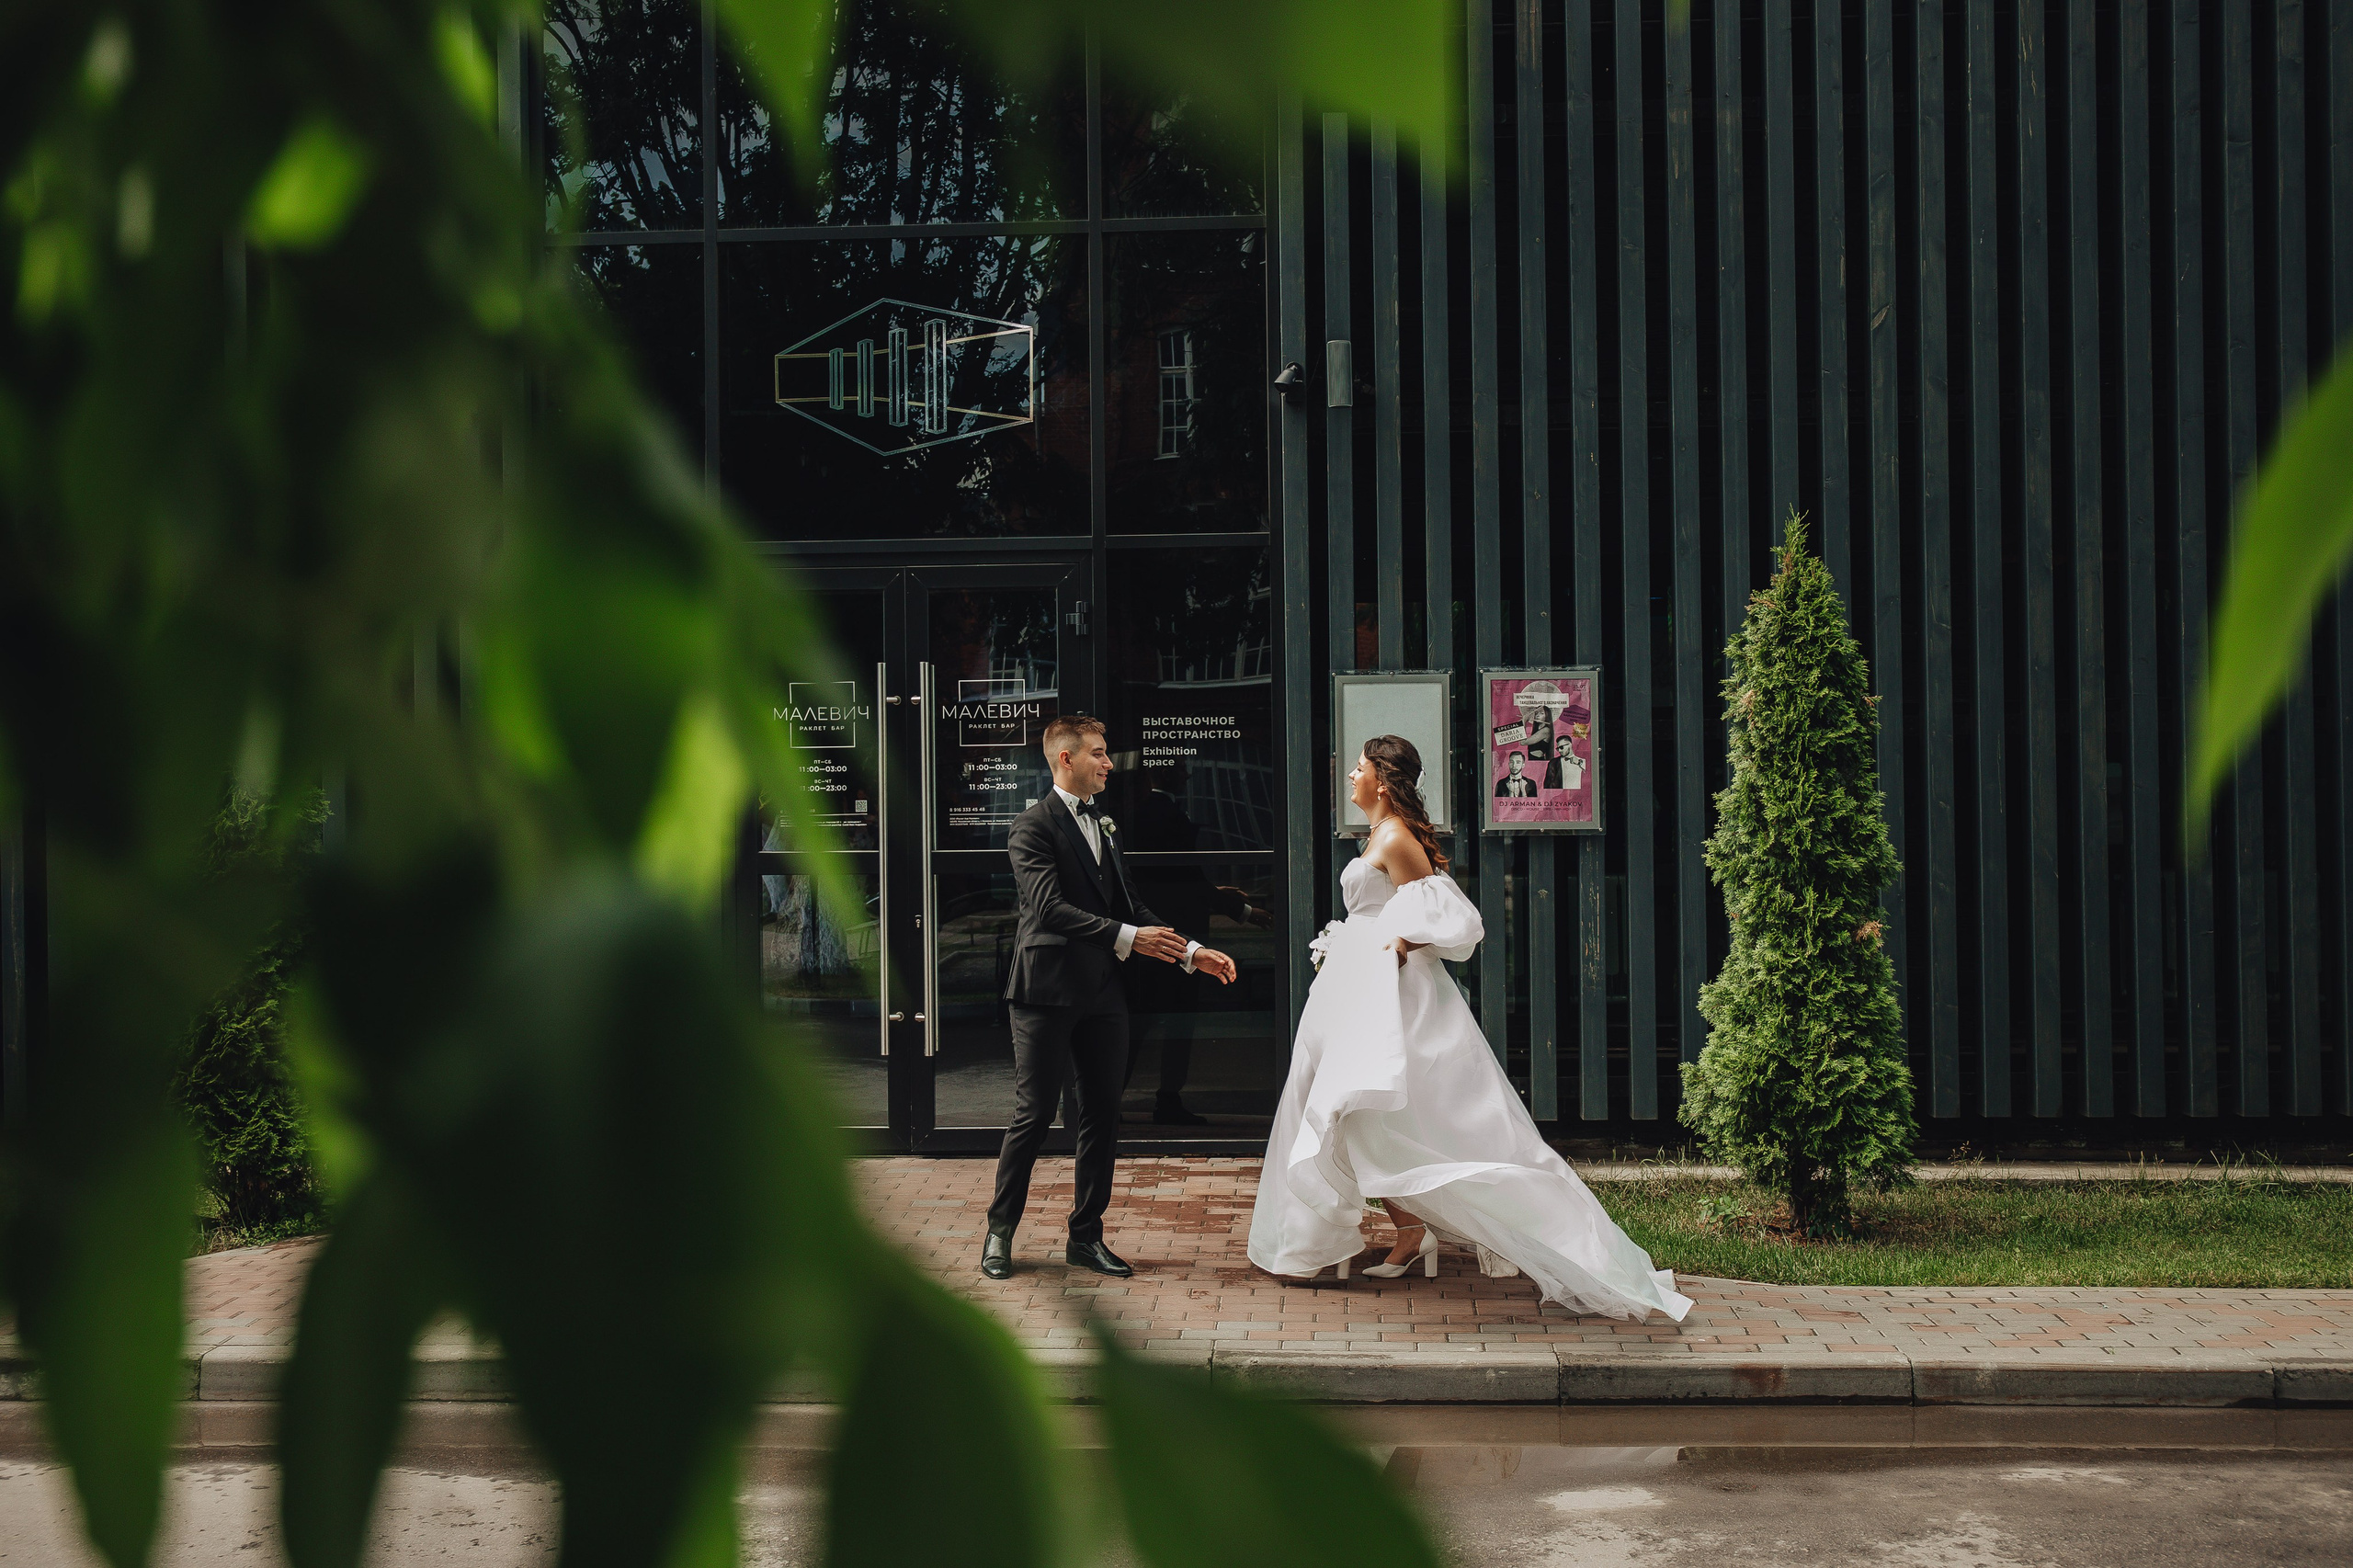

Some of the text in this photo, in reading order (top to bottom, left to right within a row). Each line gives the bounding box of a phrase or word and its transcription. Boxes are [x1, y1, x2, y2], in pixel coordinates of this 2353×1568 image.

[773, 705, 870, 722] МАЛЕВИЧ
[942, 703, 1040, 720] МАЛЕВИЧ
[1142, 716, 1235, 726] ВЫСТАВОЧНОЕ
[1497, 723, 1519, 732] SPECIAL
[1142, 730, 1241, 740] ПРОСТРАНСТВО
[1499, 733, 1523, 744] GROOVE
[1500, 729, 1520, 738] DARIA
[1142, 746, 1198, 756] Exhibition
[1142, 758, 1176, 768] space
